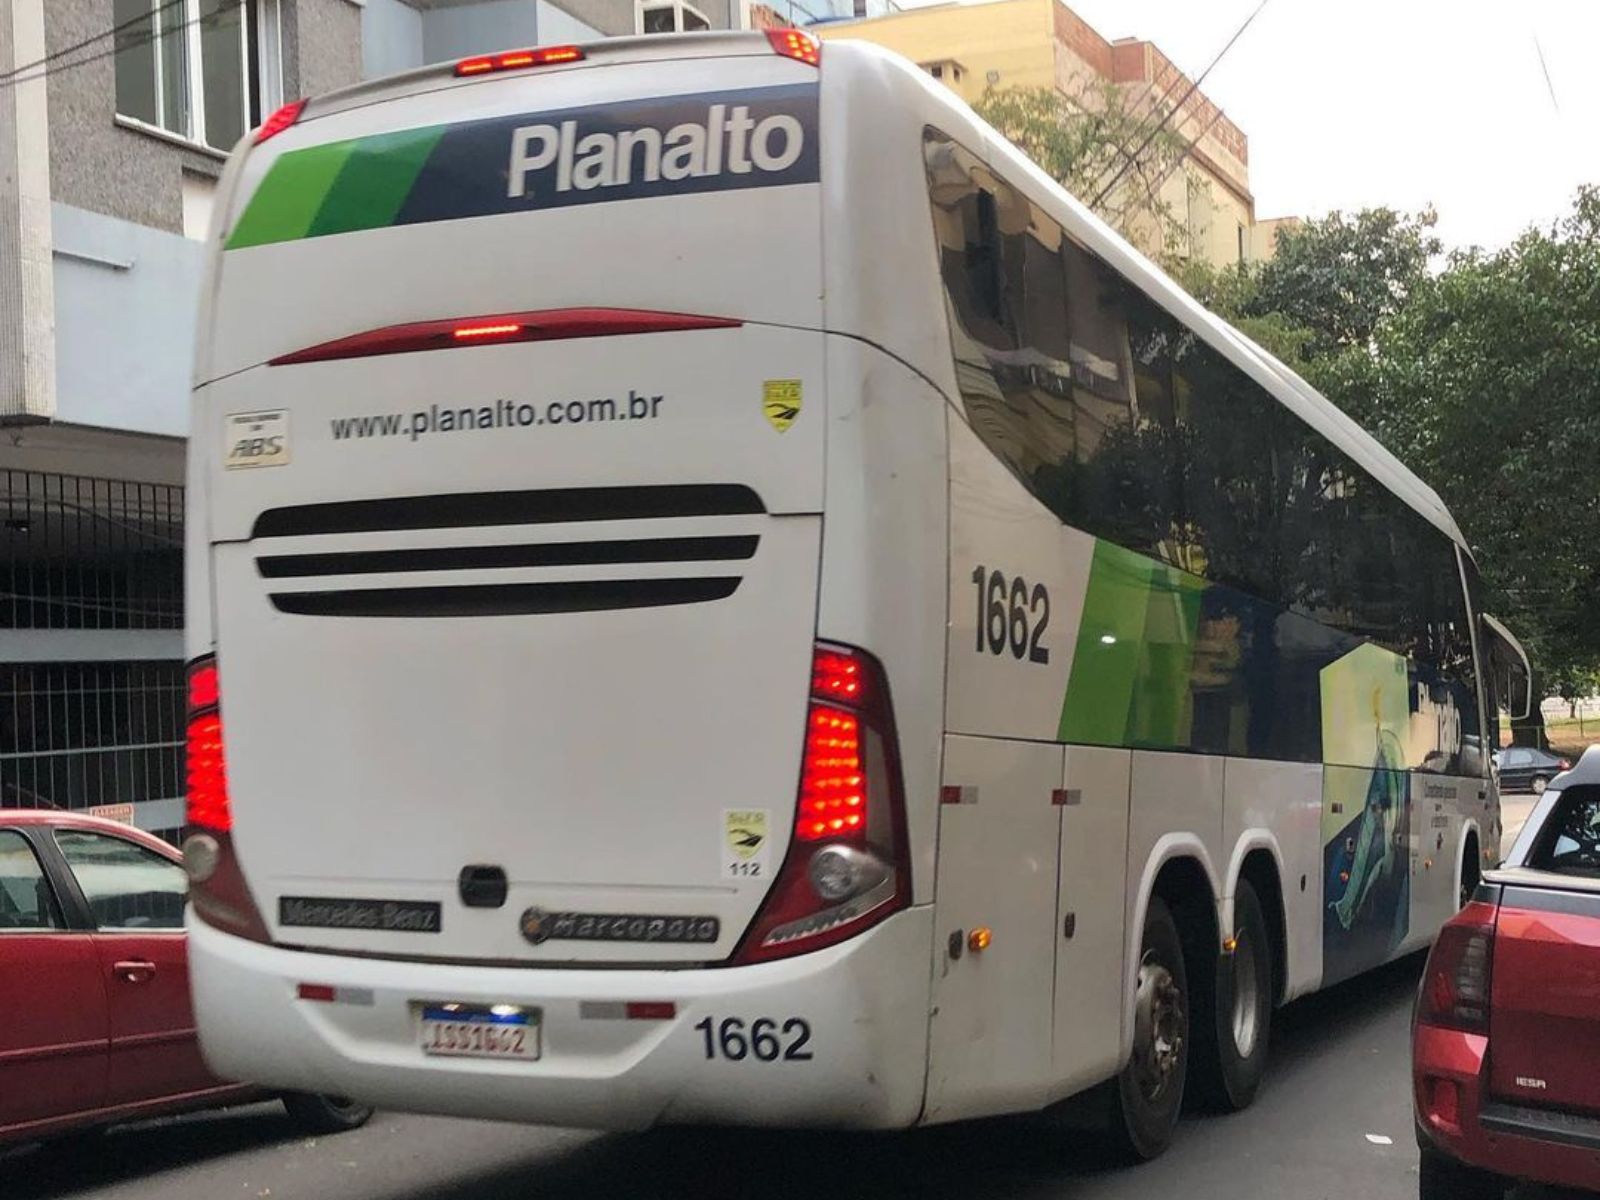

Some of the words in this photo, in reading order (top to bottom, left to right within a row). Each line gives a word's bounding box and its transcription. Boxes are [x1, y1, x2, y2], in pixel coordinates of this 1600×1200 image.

[507, 104, 803, 198] Planalto
[331, 390, 664, 441] www.planalto.com.br
[229, 436, 284, 458] ABS
[972, 565, 1050, 665] 1662
[729, 862, 761, 876] 112
[694, 1016, 813, 1061] 1662
[1516, 1076, 1546, 1089] IESA
